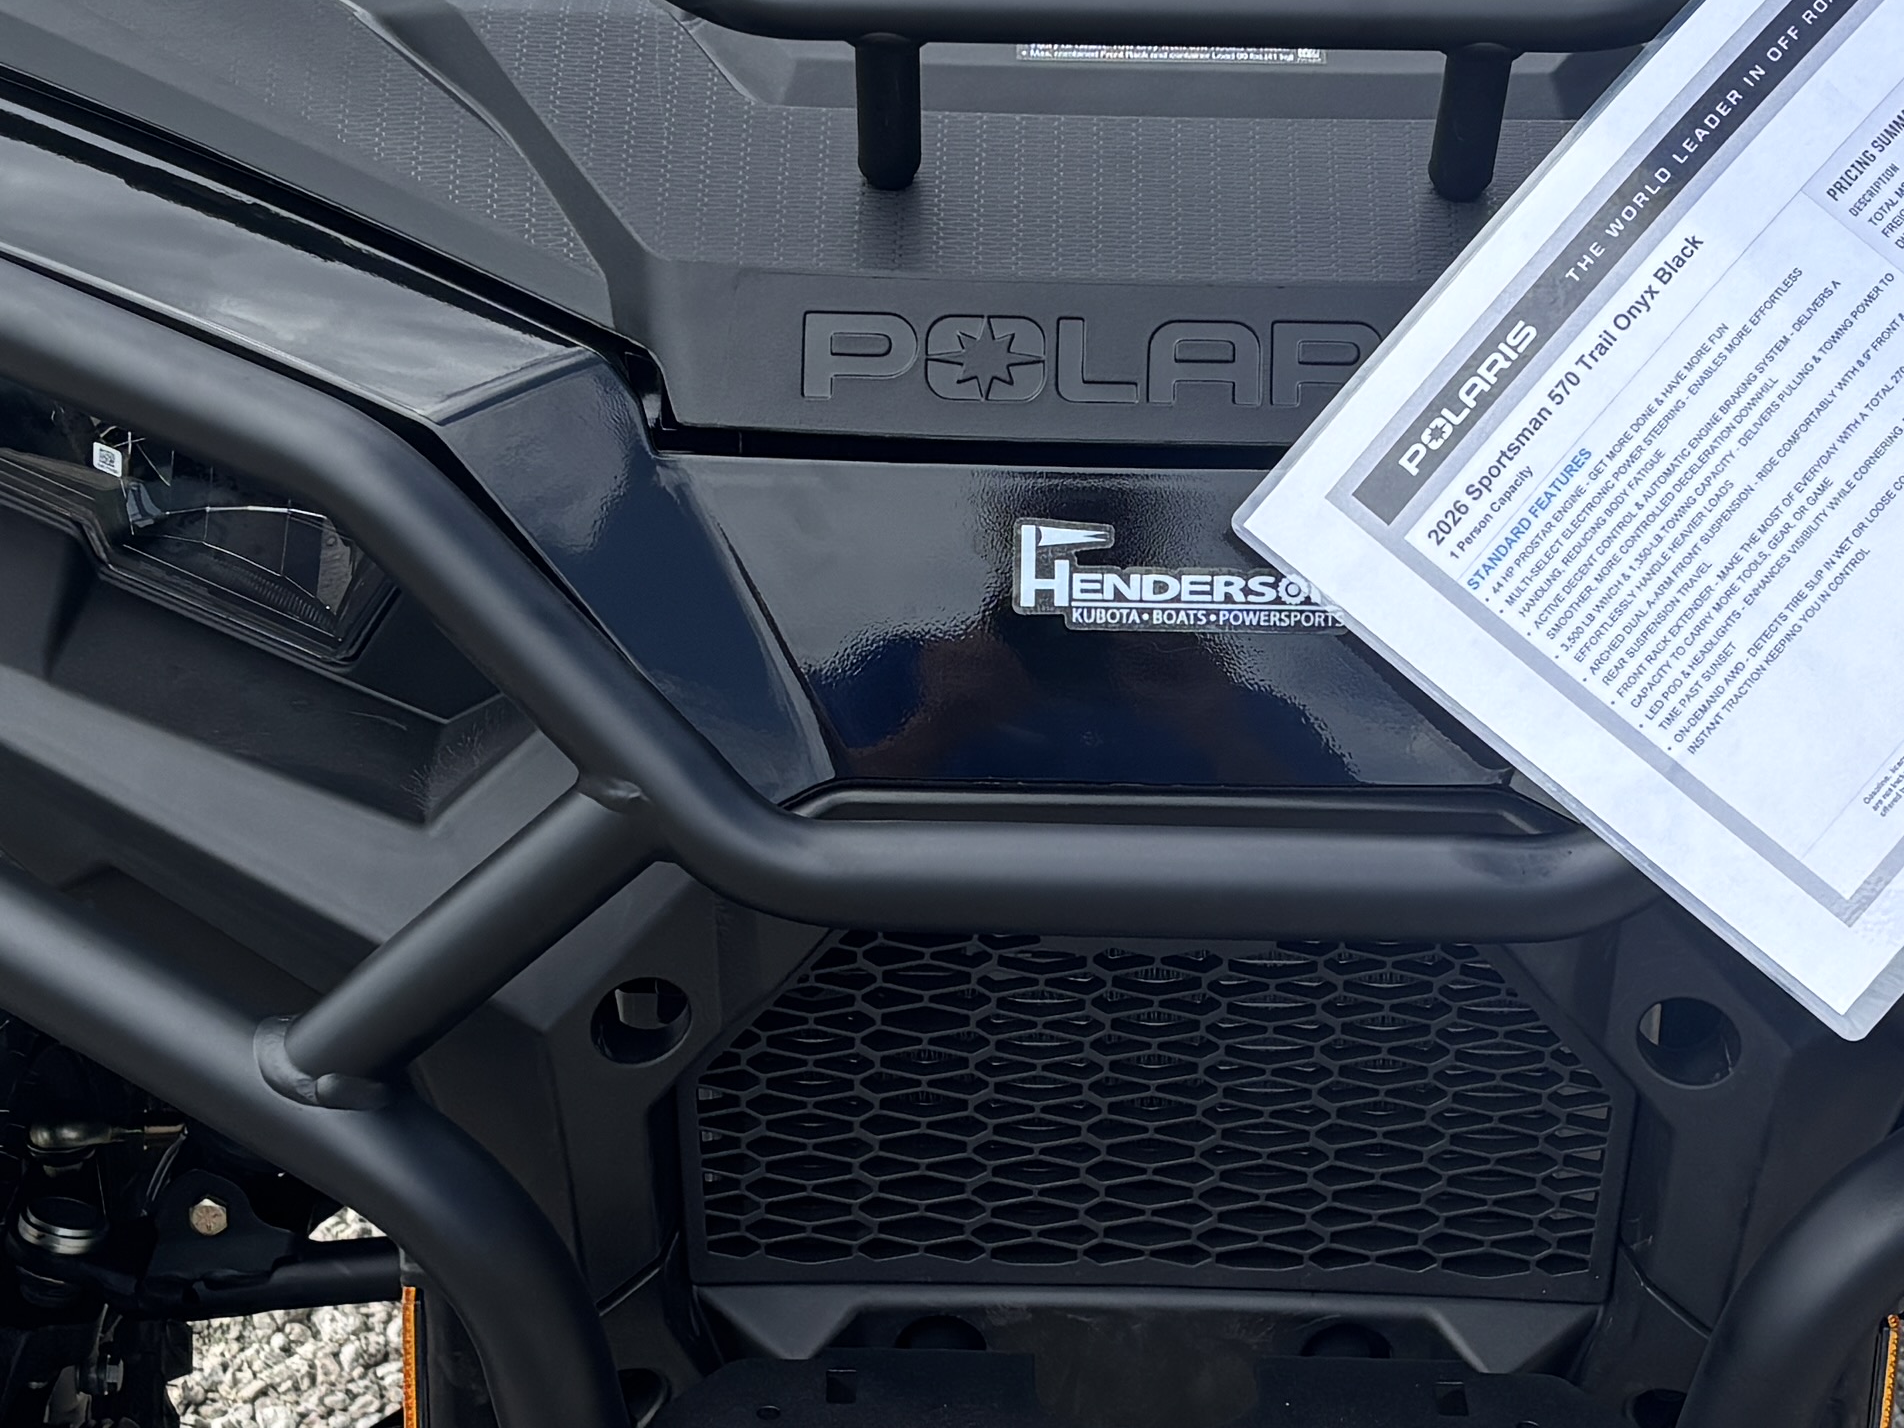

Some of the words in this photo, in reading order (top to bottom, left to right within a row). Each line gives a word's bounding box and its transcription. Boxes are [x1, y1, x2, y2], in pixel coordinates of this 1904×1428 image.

[1565, 242, 1605, 281] THE
[1605, 167, 1671, 237] WORLD
[1672, 89, 1743, 164] LEADER
[1743, 64, 1766, 87] IN
[1766, 25, 1798, 62] OFF
[1826, 150, 1877, 202] PRICING
[1848, 163, 1900, 217] DESCRIPTION
[1867, 198, 1899, 226] TOTAL
[801, 310, 1381, 407] POLAR
[1398, 320, 1540, 476] POLARIS
[1427, 500, 1469, 546] 2026
[1465, 407, 1553, 501] Sportsman
[1547, 371, 1580, 405] 570
[1575, 330, 1617, 370] Trail
[1613, 284, 1660, 331] Onyx
[1653, 235, 1704, 285] Black
[1504, 538, 1564, 606] MULTI-SELECT
[1561, 480, 1615, 540] ELECTRONIC
[1612, 445, 1646, 482] POWER
[1642, 399, 1686, 446] STEERING
[1687, 352, 1728, 396] ENABLES
[1724, 324, 1753, 354] MORE
[1748, 267, 1803, 326] EFFORTLESS
[1581, 613, 1596, 627] LB
[1592, 579, 1624, 613] WINCH
[1660, 495, 1697, 534] TOWING
[1694, 450, 1735, 497] CAPACITY
[1737, 400, 1780, 447] DELIVERS
[1777, 362, 1814, 403] PULLING
[1817, 318, 1854, 355] TOWING
[1850, 285, 1884, 320] POWER
[1878, 272, 1895, 287] TO
[1450, 551, 1459, 559] 1
[1456, 513, 1493, 552] Person
[1490, 466, 1533, 513] Capacity
[1467, 517, 1532, 590] STANDARD
[1528, 448, 1592, 519] FEATURES
[1492, 581, 1504, 594] 44
[1501, 566, 1514, 582] HP
[1513, 521, 1556, 568] PROSTAR
[1552, 485, 1587, 523] ENGINE
[1588, 458, 1608, 481] GET
[1605, 430, 1634, 461] MORE
[1629, 404, 1658, 433] DONE
[1661, 370, 1687, 398] HAVE
[1683, 342, 1712, 372] MORE
[1707, 323, 1729, 345] FUN
[1534, 593, 1565, 630] ACTIVE
[1562, 554, 1597, 595] DECENT
[1595, 511, 1638, 556] CONTROL
[1642, 448, 1691, 503] AUTOMATIC
[1688, 412, 1722, 450] ENGINE
[1718, 372, 1758, 415] BRAKING
[1754, 335, 1791, 374] SYSTEM
[1792, 287, 1834, 332] DELIVERS
[1831, 280, 1841, 290] A
[1561, 516, 1607, 567] REDUCING
[1603, 488, 1629, 518] BODY
[1627, 448, 1666, 490] FATIGUE
[1593, 553, 1622, 584] MORE
[1619, 491, 1675, 555] CONTROLLED
[1672, 422, 1737, 493] DECELERATION
[1732, 378, 1779, 424] DOWNHILL
[1072, 608, 1140, 624] KUBOTA
[1152, 609, 1207, 625] BOATS
[1219, 610, 1345, 627] POWERSPORTS
[1573, 589, 1637, 663] EFFORTLESSLY
[1635, 551, 1671, 592] HANDLE
[1667, 511, 1707, 554] HEAVIER
[1703, 479, 1734, 513] LOADS
[1644, 700, 1664, 721] LED
[1661, 678, 1683, 701] POD
[1687, 609, 1742, 671] HEADLIGHTS
[1743, 554, 1791, 606] ENHANCES
[1787, 509, 1828, 554] VISIBILITY
[1826, 479, 1856, 510] WHILE
[1674, 685, 1725, 743] ON-DEMAND
[1724, 661, 1746, 687] AWD
[1747, 612, 1788, 658] DETECTS
[1784, 589, 1808, 612] TIRE
[1804, 569, 1824, 592] SLIP
[1823, 558, 1836, 571] IN
[1831, 536, 1854, 559] WET
[1851, 522, 1869, 538] OR
[1864, 489, 1897, 523] LOOSE
[1687, 712, 1724, 755] INSTANT
[1721, 664, 1767, 713] TRACTION
[1763, 623, 1803, 666] KEEPING
[1799, 601, 1821, 623] YOU
[1817, 590, 1831, 603] IN
[1827, 548, 1871, 592] CONTROL
[1658, 706, 1682, 730] TIME
[1678, 680, 1703, 708] PAST
[1701, 641, 1736, 682] SUNSET
